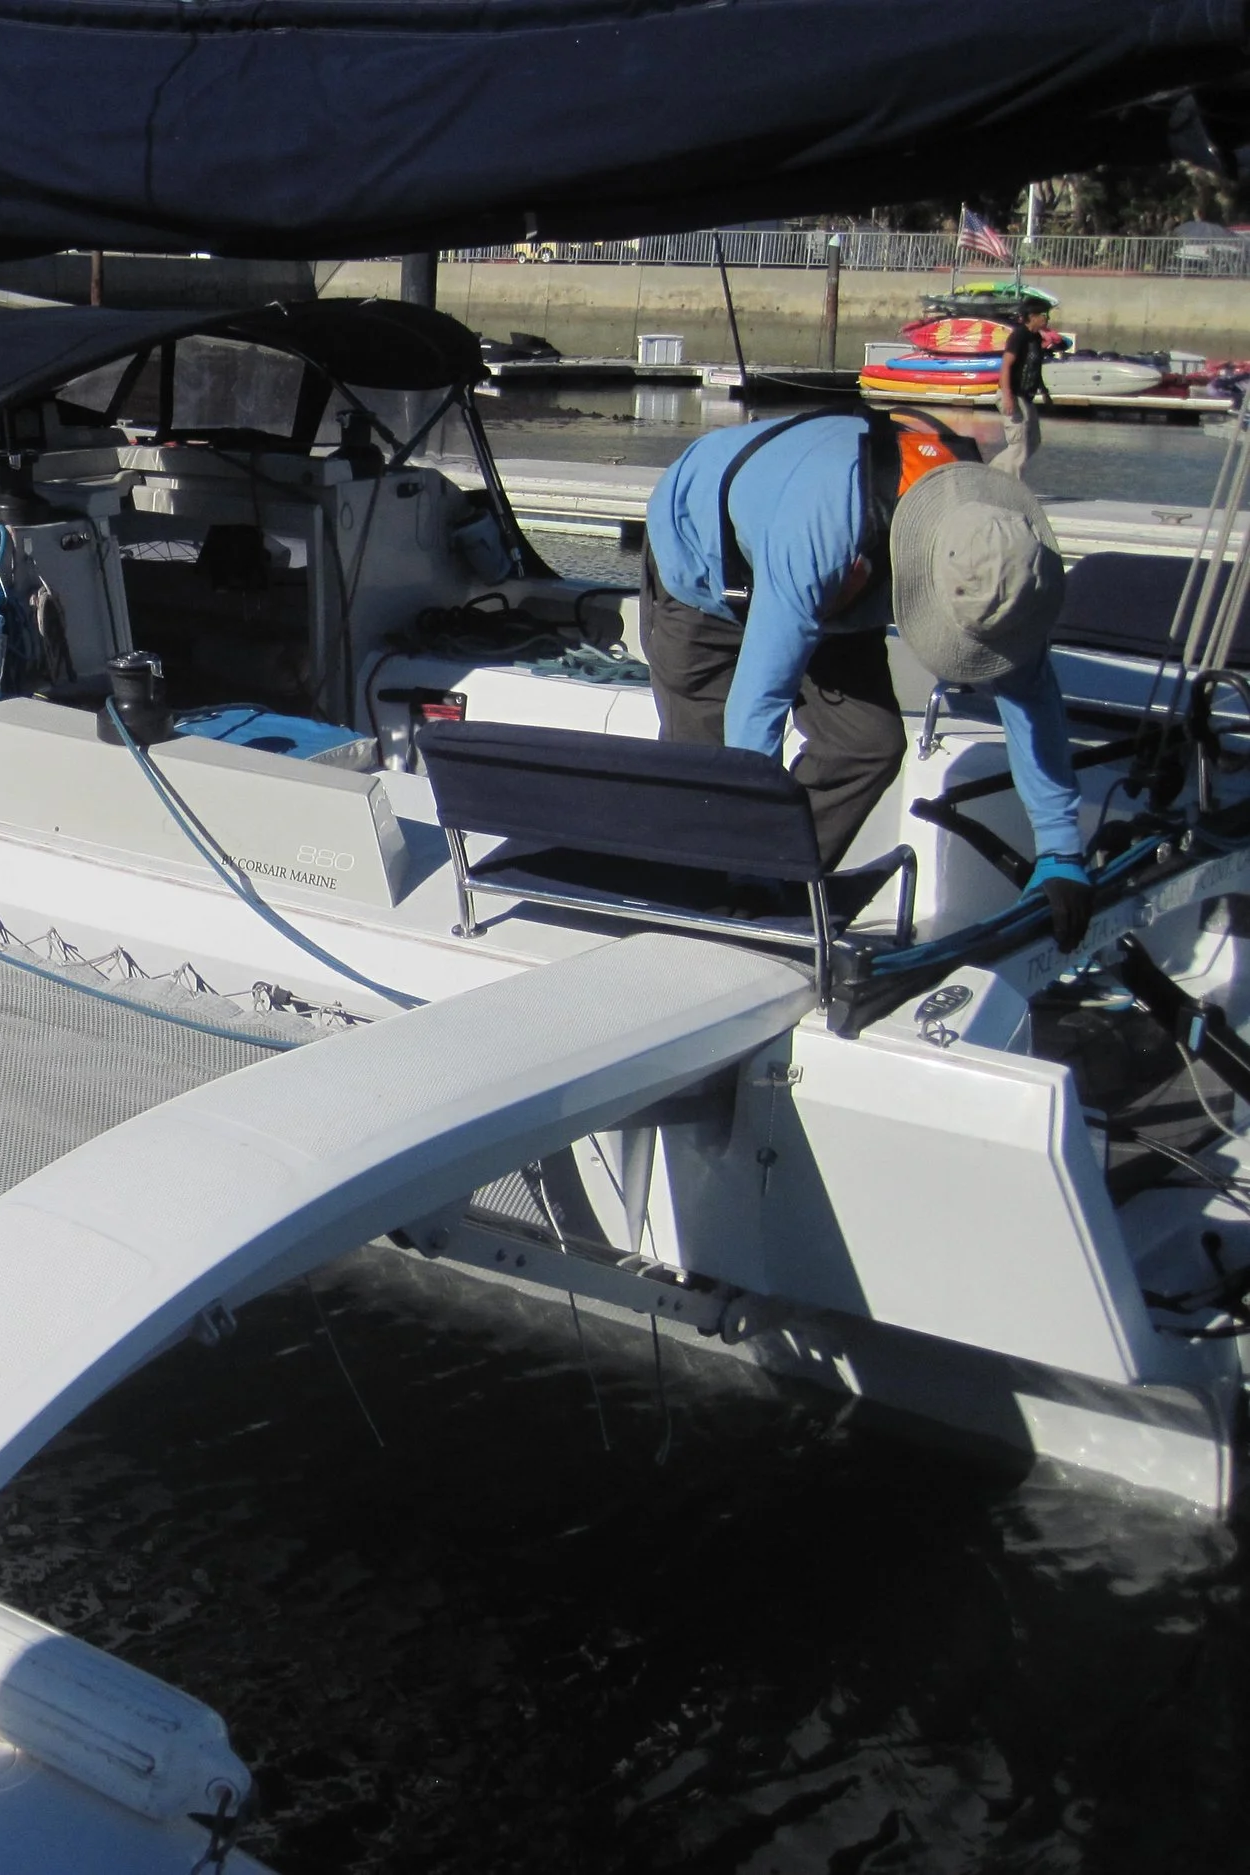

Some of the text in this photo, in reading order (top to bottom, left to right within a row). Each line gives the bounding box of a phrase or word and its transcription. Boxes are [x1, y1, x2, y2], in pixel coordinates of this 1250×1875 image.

[220, 854, 338, 891] BY CORSAIR MARINE
[296, 845, 355, 872] 880
